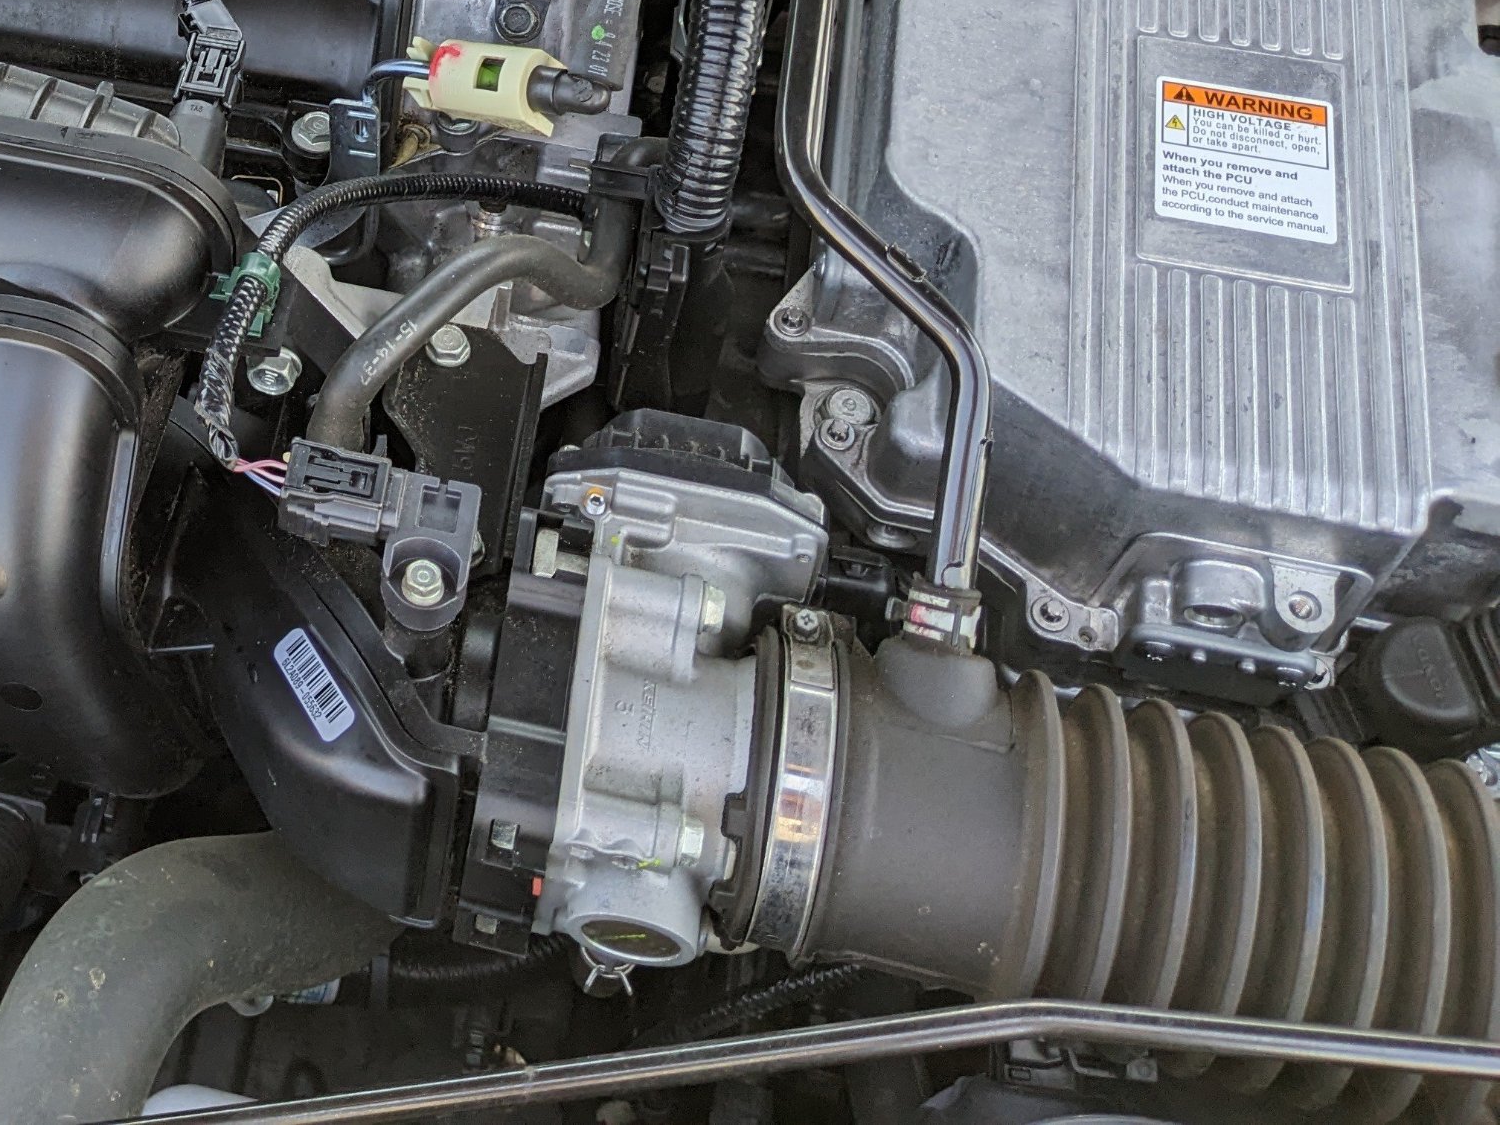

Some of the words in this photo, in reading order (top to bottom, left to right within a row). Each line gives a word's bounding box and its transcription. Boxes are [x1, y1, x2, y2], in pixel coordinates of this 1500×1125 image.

[1193, 108, 1225, 121] HIGH
[1230, 114, 1292, 131] VOLTAGE
[1204, 91, 1313, 121] WARNING
[1192, 126, 1206, 135] Do
[1209, 129, 1226, 139] not
[1229, 132, 1287, 150] disconnect,
[1291, 143, 1320, 155] open,
[1193, 117, 1213, 127] You
[1215, 122, 1233, 130] can
[1236, 123, 1250, 134] be
[1253, 126, 1280, 139] killed
[1283, 131, 1295, 141] or
[1298, 133, 1321, 146] hurt.
[1206, 137, 1228, 148] take
[1231, 142, 1261, 155] apart.
[1162, 150, 1197, 164] When
[1200, 156, 1222, 169] you
[1226, 161, 1272, 176] remove
[1275, 169, 1298, 181] and
[1162, 163, 1200, 177] attach
[1203, 169, 1222, 180] the
[1226, 173, 1252, 185] PCU
[1162, 174, 1192, 187] When
[1195, 180, 1214, 191] you
[1216, 185, 1255, 198] remove
[1258, 191, 1278, 201] and
[1281, 194, 1312, 208] attach
[1162, 186, 1178, 197] the
[1252, 202, 1319, 221] maintenance
[1162, 199, 1212, 217] according
[1214, 207, 1225, 217] to
[1227, 210, 1244, 220] the
[1247, 213, 1284, 227] service
[1287, 220, 1329, 235] manual.
